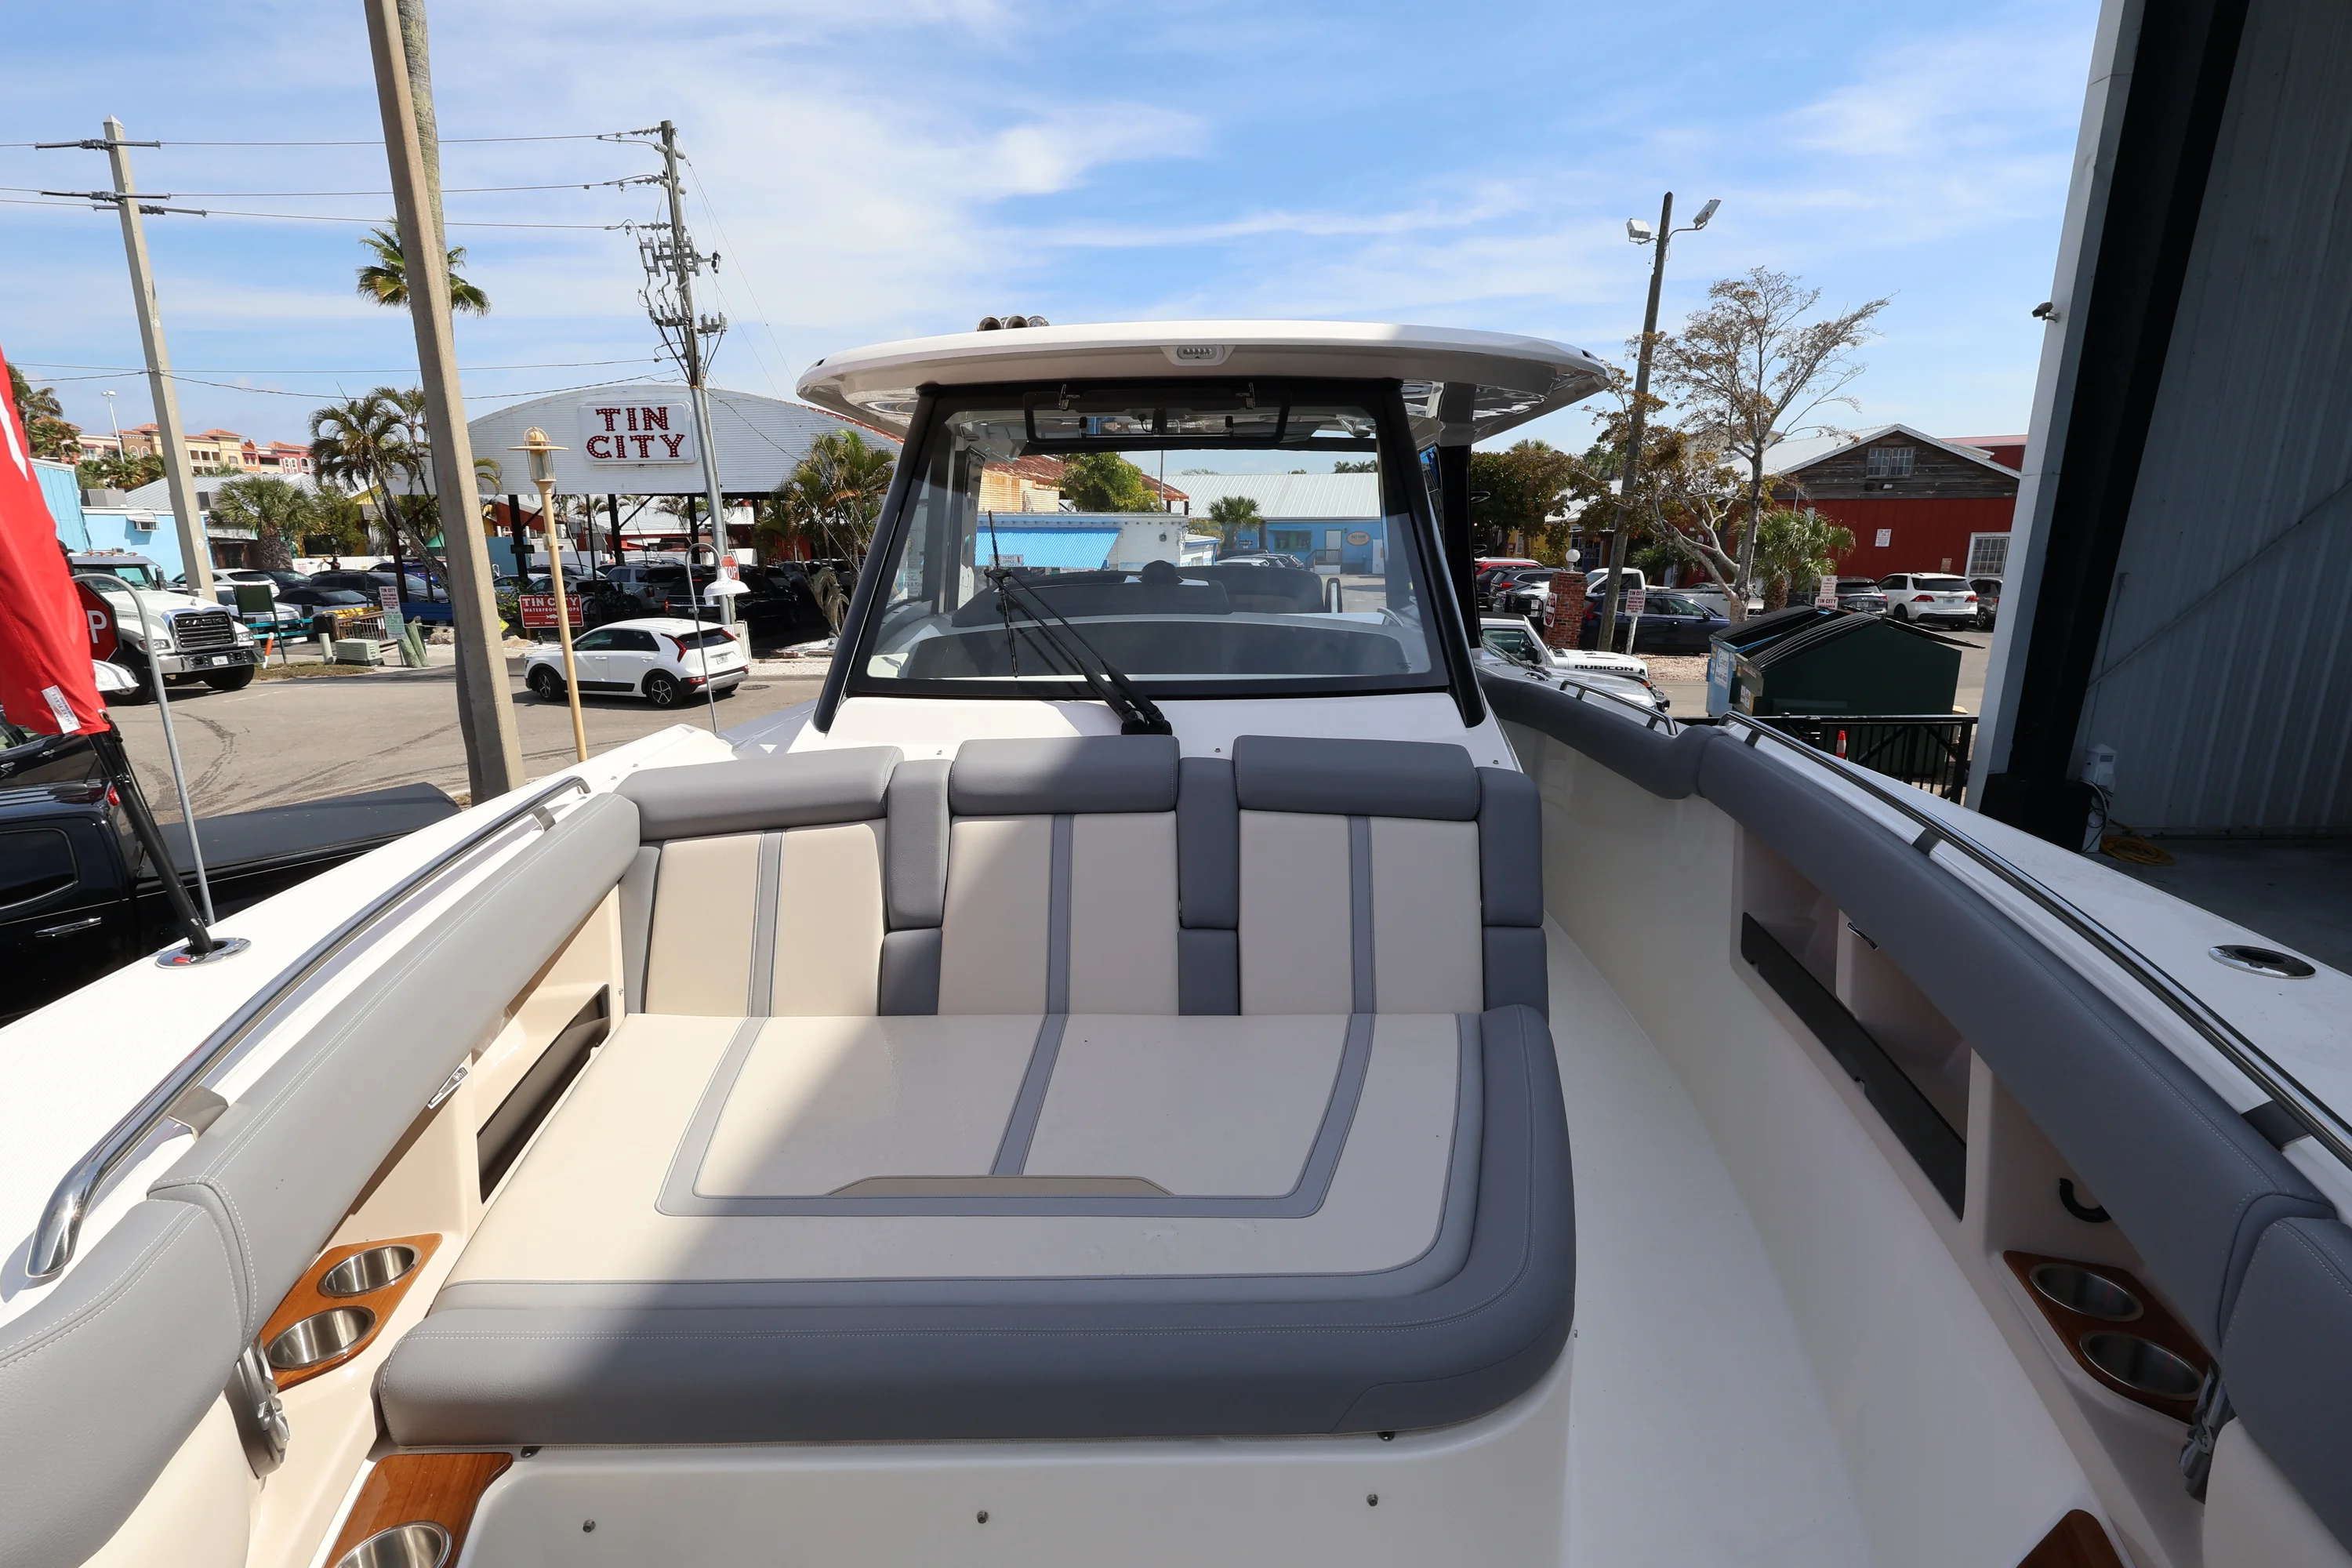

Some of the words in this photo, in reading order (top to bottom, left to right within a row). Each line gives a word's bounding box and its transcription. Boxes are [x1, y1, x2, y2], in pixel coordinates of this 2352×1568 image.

[595, 407, 670, 431] TIN
[586, 434, 685, 459] CITY
[522, 597, 545, 607] TIN
[547, 597, 578, 606] CY
